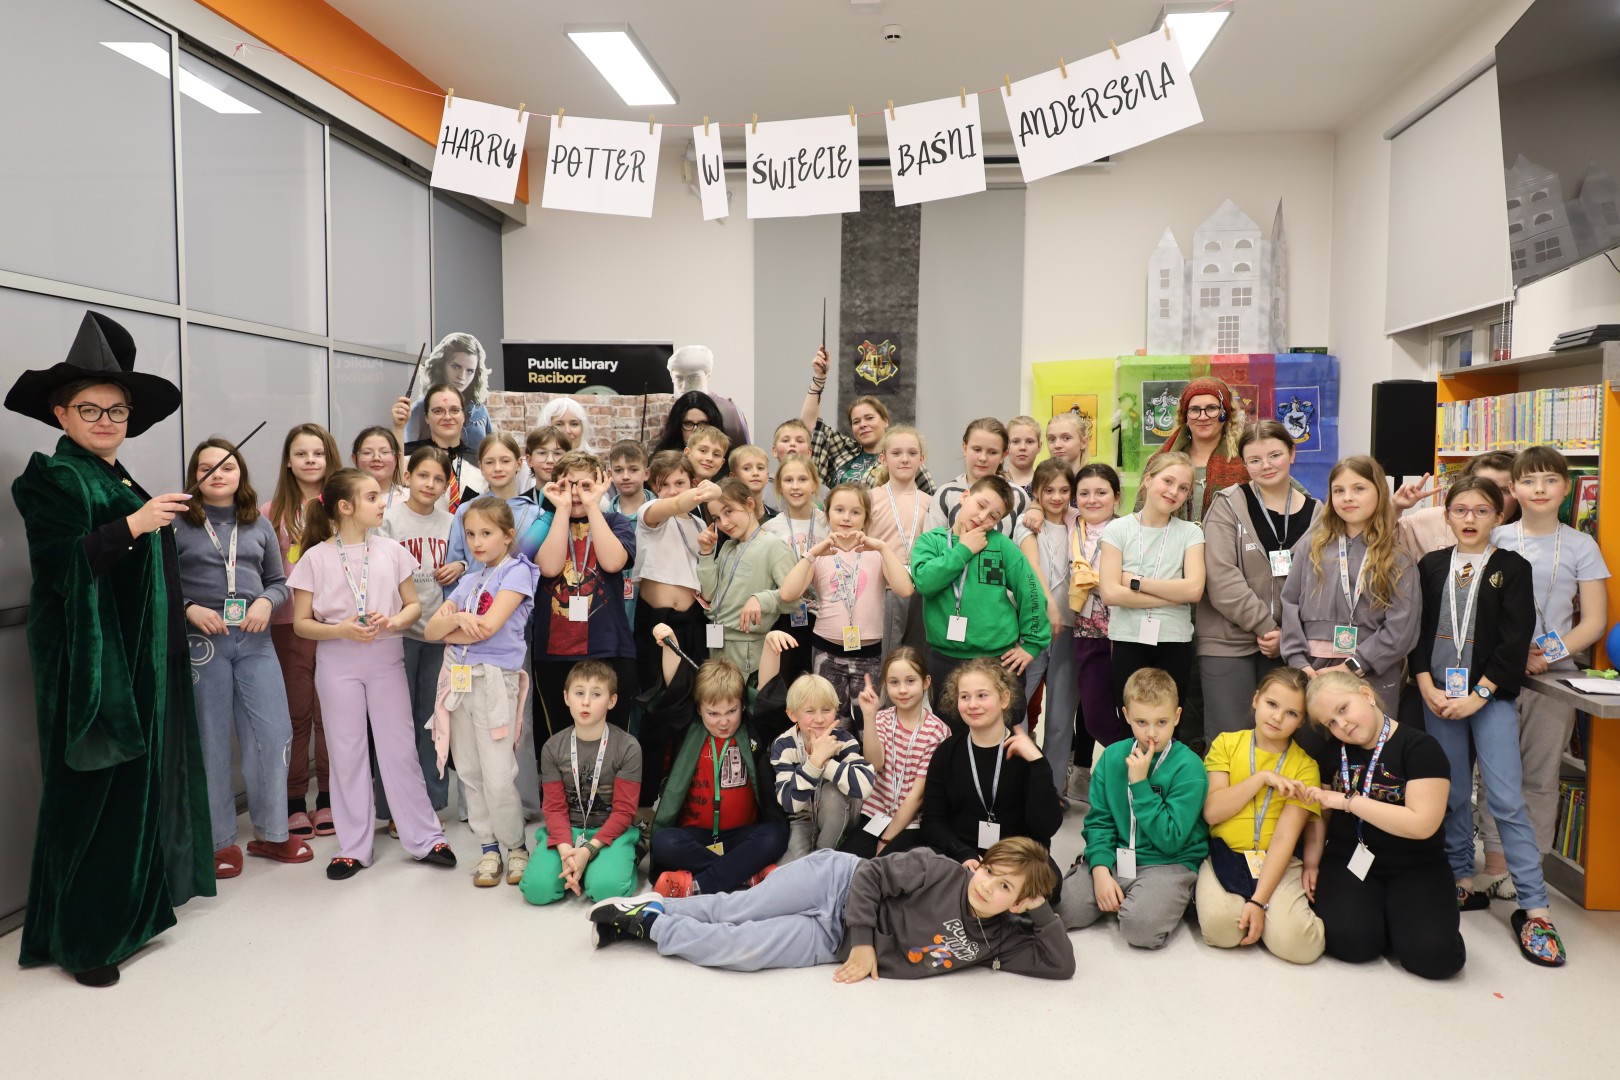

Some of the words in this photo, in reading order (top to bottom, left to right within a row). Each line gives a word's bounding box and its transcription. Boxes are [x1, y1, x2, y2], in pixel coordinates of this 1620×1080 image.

[441, 125, 518, 169] HARRY
[551, 144, 646, 183] POTTER
[703, 154, 720, 186] W
[752, 153, 853, 191] ŚWIECIE
[898, 124, 977, 176] BAŚNI
[1018, 61, 1176, 147] ANDERSENA
[528, 358, 569, 370] Public
[571, 358, 619, 373] Library
[528, 372, 587, 384] Raciborz
